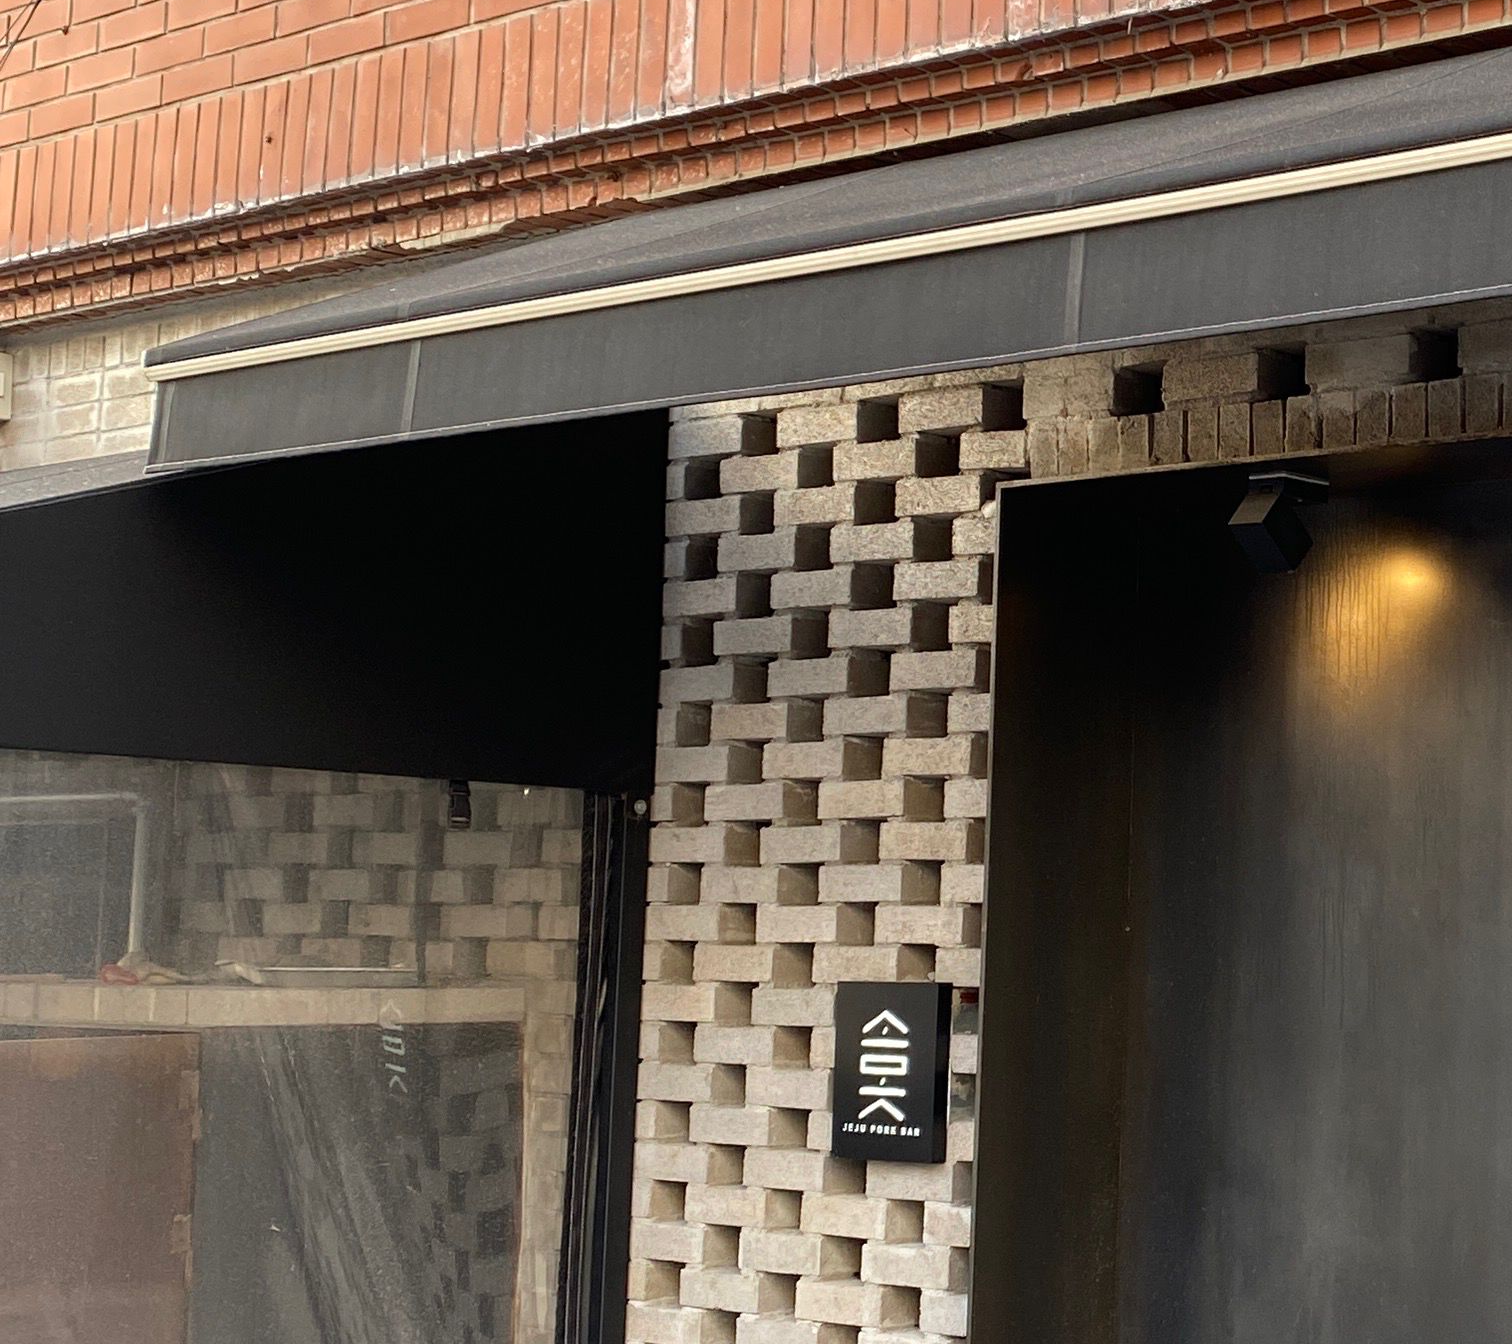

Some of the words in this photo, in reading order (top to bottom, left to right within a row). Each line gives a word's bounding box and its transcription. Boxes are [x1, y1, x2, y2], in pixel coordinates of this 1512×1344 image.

[842, 1122, 867, 1133] JEJU
[869, 1124, 897, 1136] PORK
[900, 1126, 921, 1137] BAR
